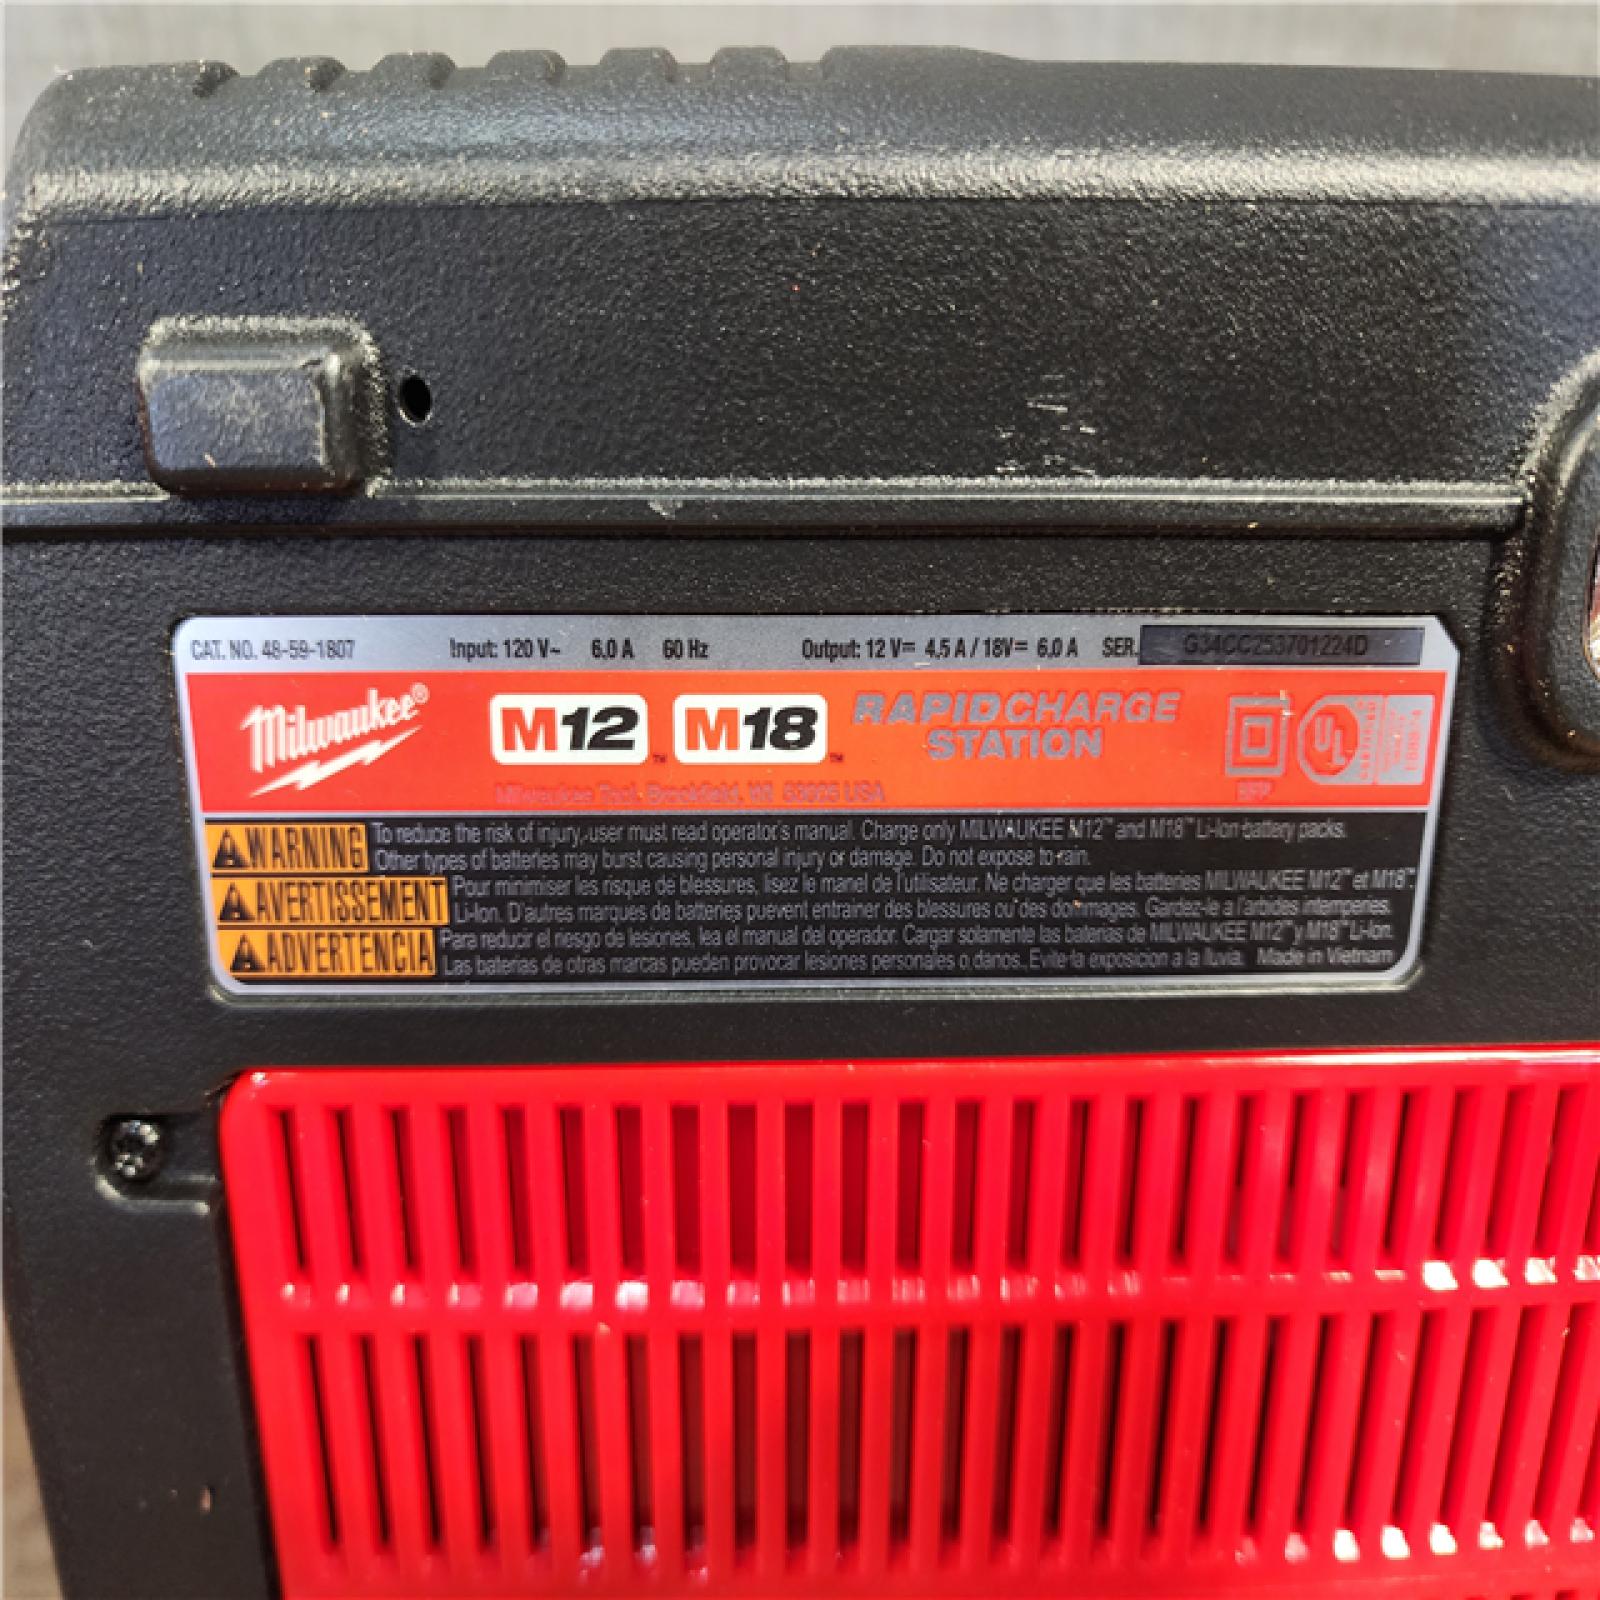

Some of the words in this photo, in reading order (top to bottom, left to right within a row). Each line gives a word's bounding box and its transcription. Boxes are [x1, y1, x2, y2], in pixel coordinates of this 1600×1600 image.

[191, 639, 225, 660] CAT.
[229, 639, 258, 660] NO.
[262, 639, 355, 660] 48-59-1807
[450, 637, 498, 662] Input:
[503, 638, 533, 658] 120
[591, 638, 618, 659] 6.0
[622, 638, 635, 658] A
[663, 638, 683, 658] 60
[687, 638, 709, 658] Hz
[802, 637, 861, 662] Output:
[865, 638, 886, 658] 12
[924, 637, 951, 660] 4.5
[954, 637, 966, 657] A
[969, 637, 980, 658] /
[1037, 637, 1064, 658] 6.0
[1066, 637, 1079, 657] A
[1102, 637, 1138, 658] SER.
[501, 705, 639, 751] M12
[685, 705, 819, 751] M18
[928, 727, 1104, 760] STATION
[495, 781, 593, 804] Milwaukee
[844, 781, 885, 803] USA
[371, 821, 391, 843] To
[397, 821, 450, 843] reduce
[454, 822, 480, 843] the
[484, 821, 512, 843] risk
[517, 820, 535, 843] of
[627, 822, 667, 843] must
[672, 820, 708, 841] read
[862, 819, 918, 845] Charge
[922, 819, 955, 845] only
[959, 817, 1064, 840] MILWAUKEE
[1114, 818, 1146, 839] and
[245, 826, 362, 868] WARNING
[376, 849, 420, 871] Other
[423, 848, 468, 875] types
[470, 848, 486, 871] of
[491, 848, 560, 871] batteries
[563, 851, 598, 875] may
[602, 848, 643, 869] burst
[646, 848, 708, 873] causing
[712, 847, 779, 873] personal
[782, 847, 824, 873] injury
[829, 850, 845, 866] or
[922, 845, 945, 866] Do
[949, 847, 975, 866] not
[977, 848, 1036, 870] expose
[1039, 847, 1053, 866] to
[453, 875, 491, 896] Pour
[494, 874, 572, 896] minimiser
[575, 874, 599, 896] les
[602, 874, 651, 901] risque
[654, 874, 676, 896] de
[764, 872, 799, 893] lisez
[872, 873, 893, 893] de
[985, 871, 1008, 893] Ne
[1012, 870, 1072, 898] charger
[1075, 876, 1106, 897] que
[1110, 870, 1132, 893] les
[1204, 869, 1305, 890] MILWAUKEE
[1353, 871, 1369, 890] et
[256, 879, 446, 923] AVERTISSEMENT
[578, 905, 648, 925] marques
[651, 900, 671, 921] de
[885, 898, 913, 919] des
[917, 898, 991, 919] blessures
[1019, 898, 1048, 919] des
[440, 928, 478, 950] Para
[479, 928, 533, 949] reducir
[537, 928, 550, 948] el
[554, 928, 600, 953] riesgo
[604, 927, 626, 948] de
[700, 926, 721, 946] lea
[725, 925, 739, 946] el
[742, 925, 799, 946] manual
[802, 925, 826, 945] del
[903, 924, 955, 953] Cargar
[1039, 922, 1061, 944] las
[1127, 921, 1146, 943] de
[1294, 924, 1305, 945] y
[267, 932, 433, 974] ADVERTENCIA
[443, 955, 473, 976] Las
[542, 954, 562, 976] de
[567, 956, 606, 975] otras
[609, 957, 668, 975] marcas
[672, 952, 731, 977] pueden
[734, 954, 801, 976] provocar
[804, 950, 867, 971] lesiones
[871, 949, 955, 976] personales
[1171, 952, 1183, 968] a
[1186, 948, 1199, 967] la
[1256, 947, 1305, 966] Made
[1307, 948, 1324, 965] in
[1327, 947, 1394, 965] Vietnam
